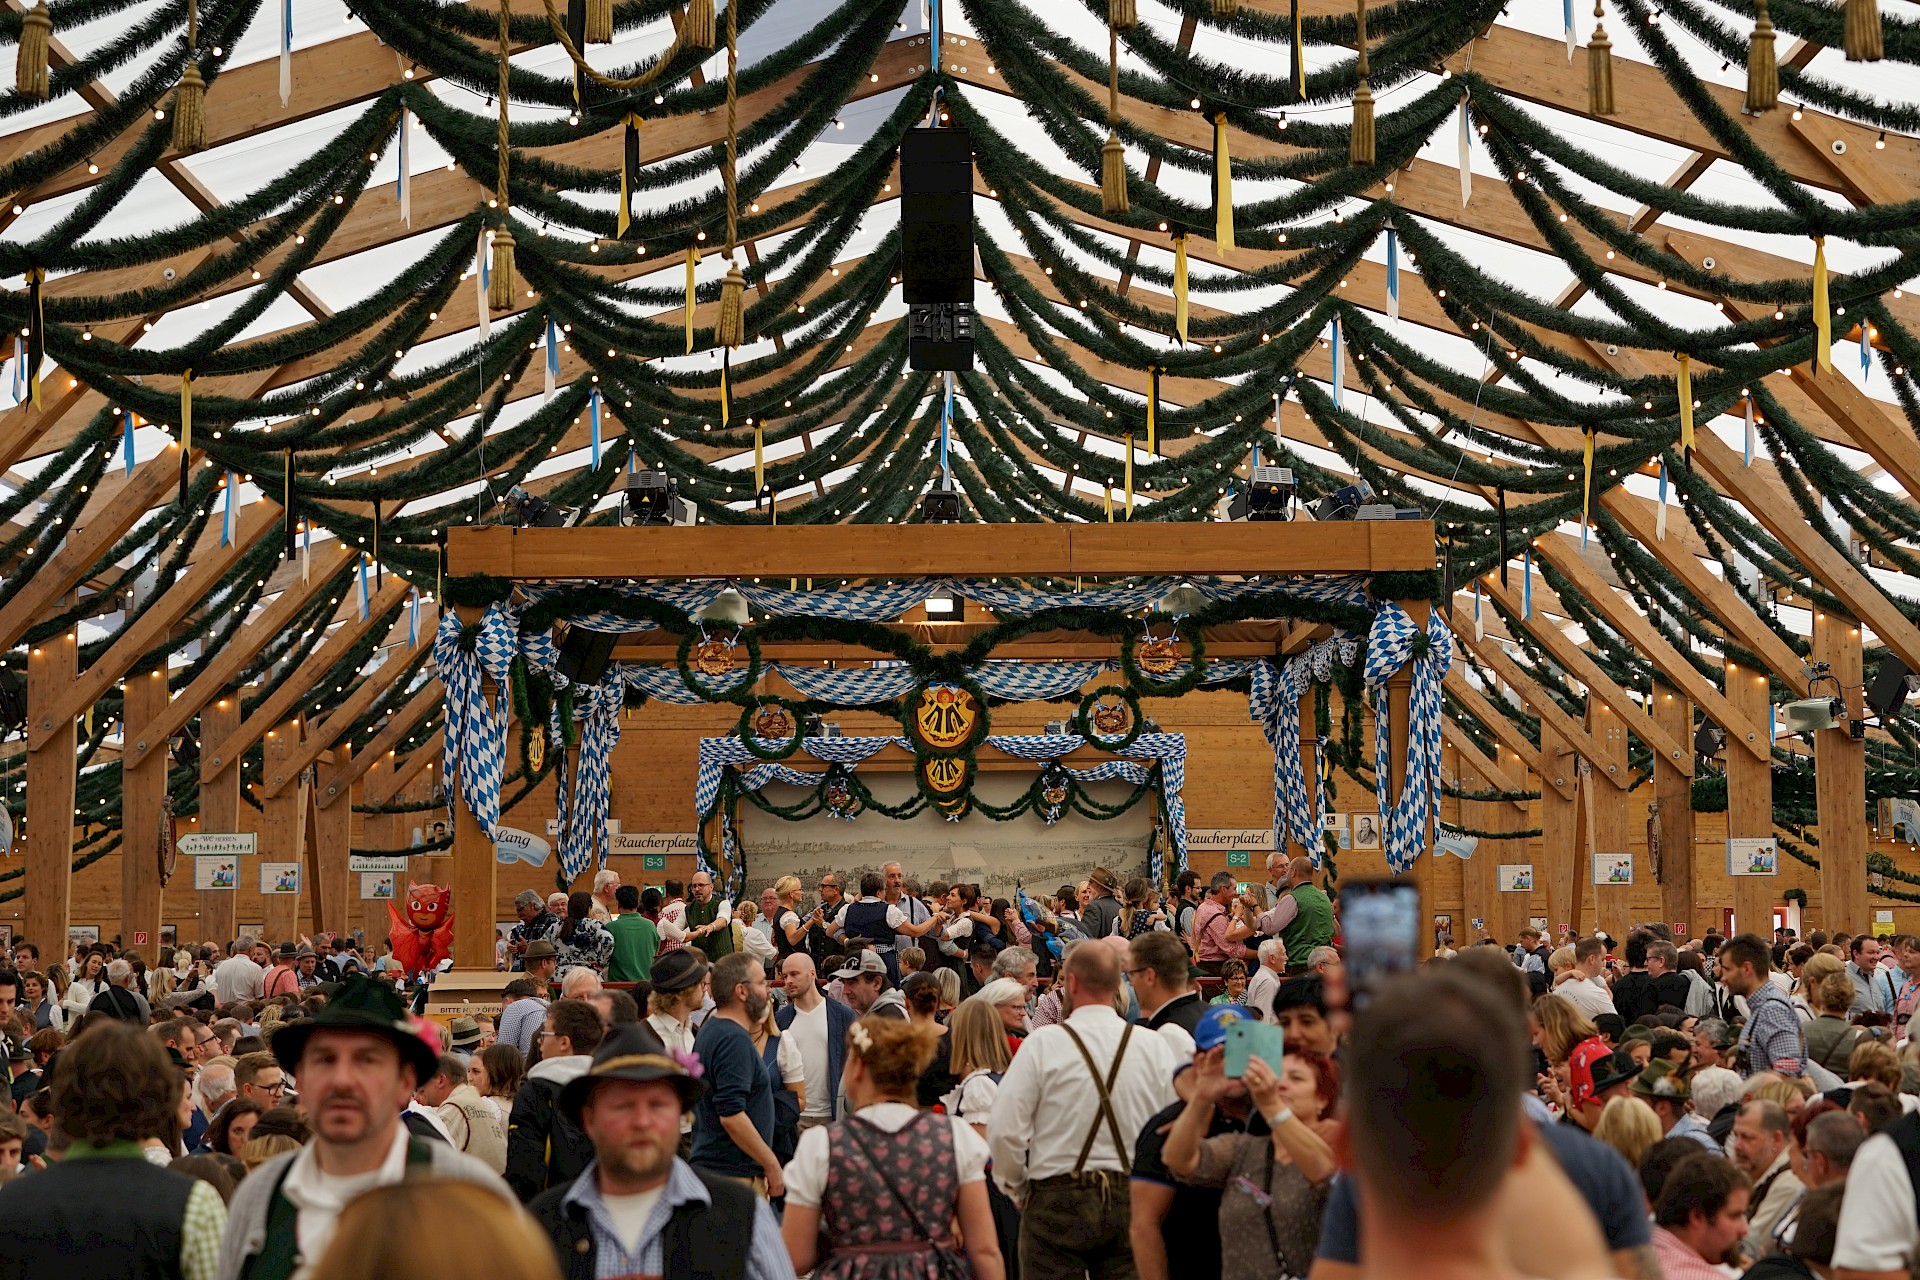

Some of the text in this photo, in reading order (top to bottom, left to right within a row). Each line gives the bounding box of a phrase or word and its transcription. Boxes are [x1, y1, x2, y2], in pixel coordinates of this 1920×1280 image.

[497, 830, 531, 849] Lang
[647, 857, 663, 867] S-3
[1230, 854, 1247, 863] S-2
